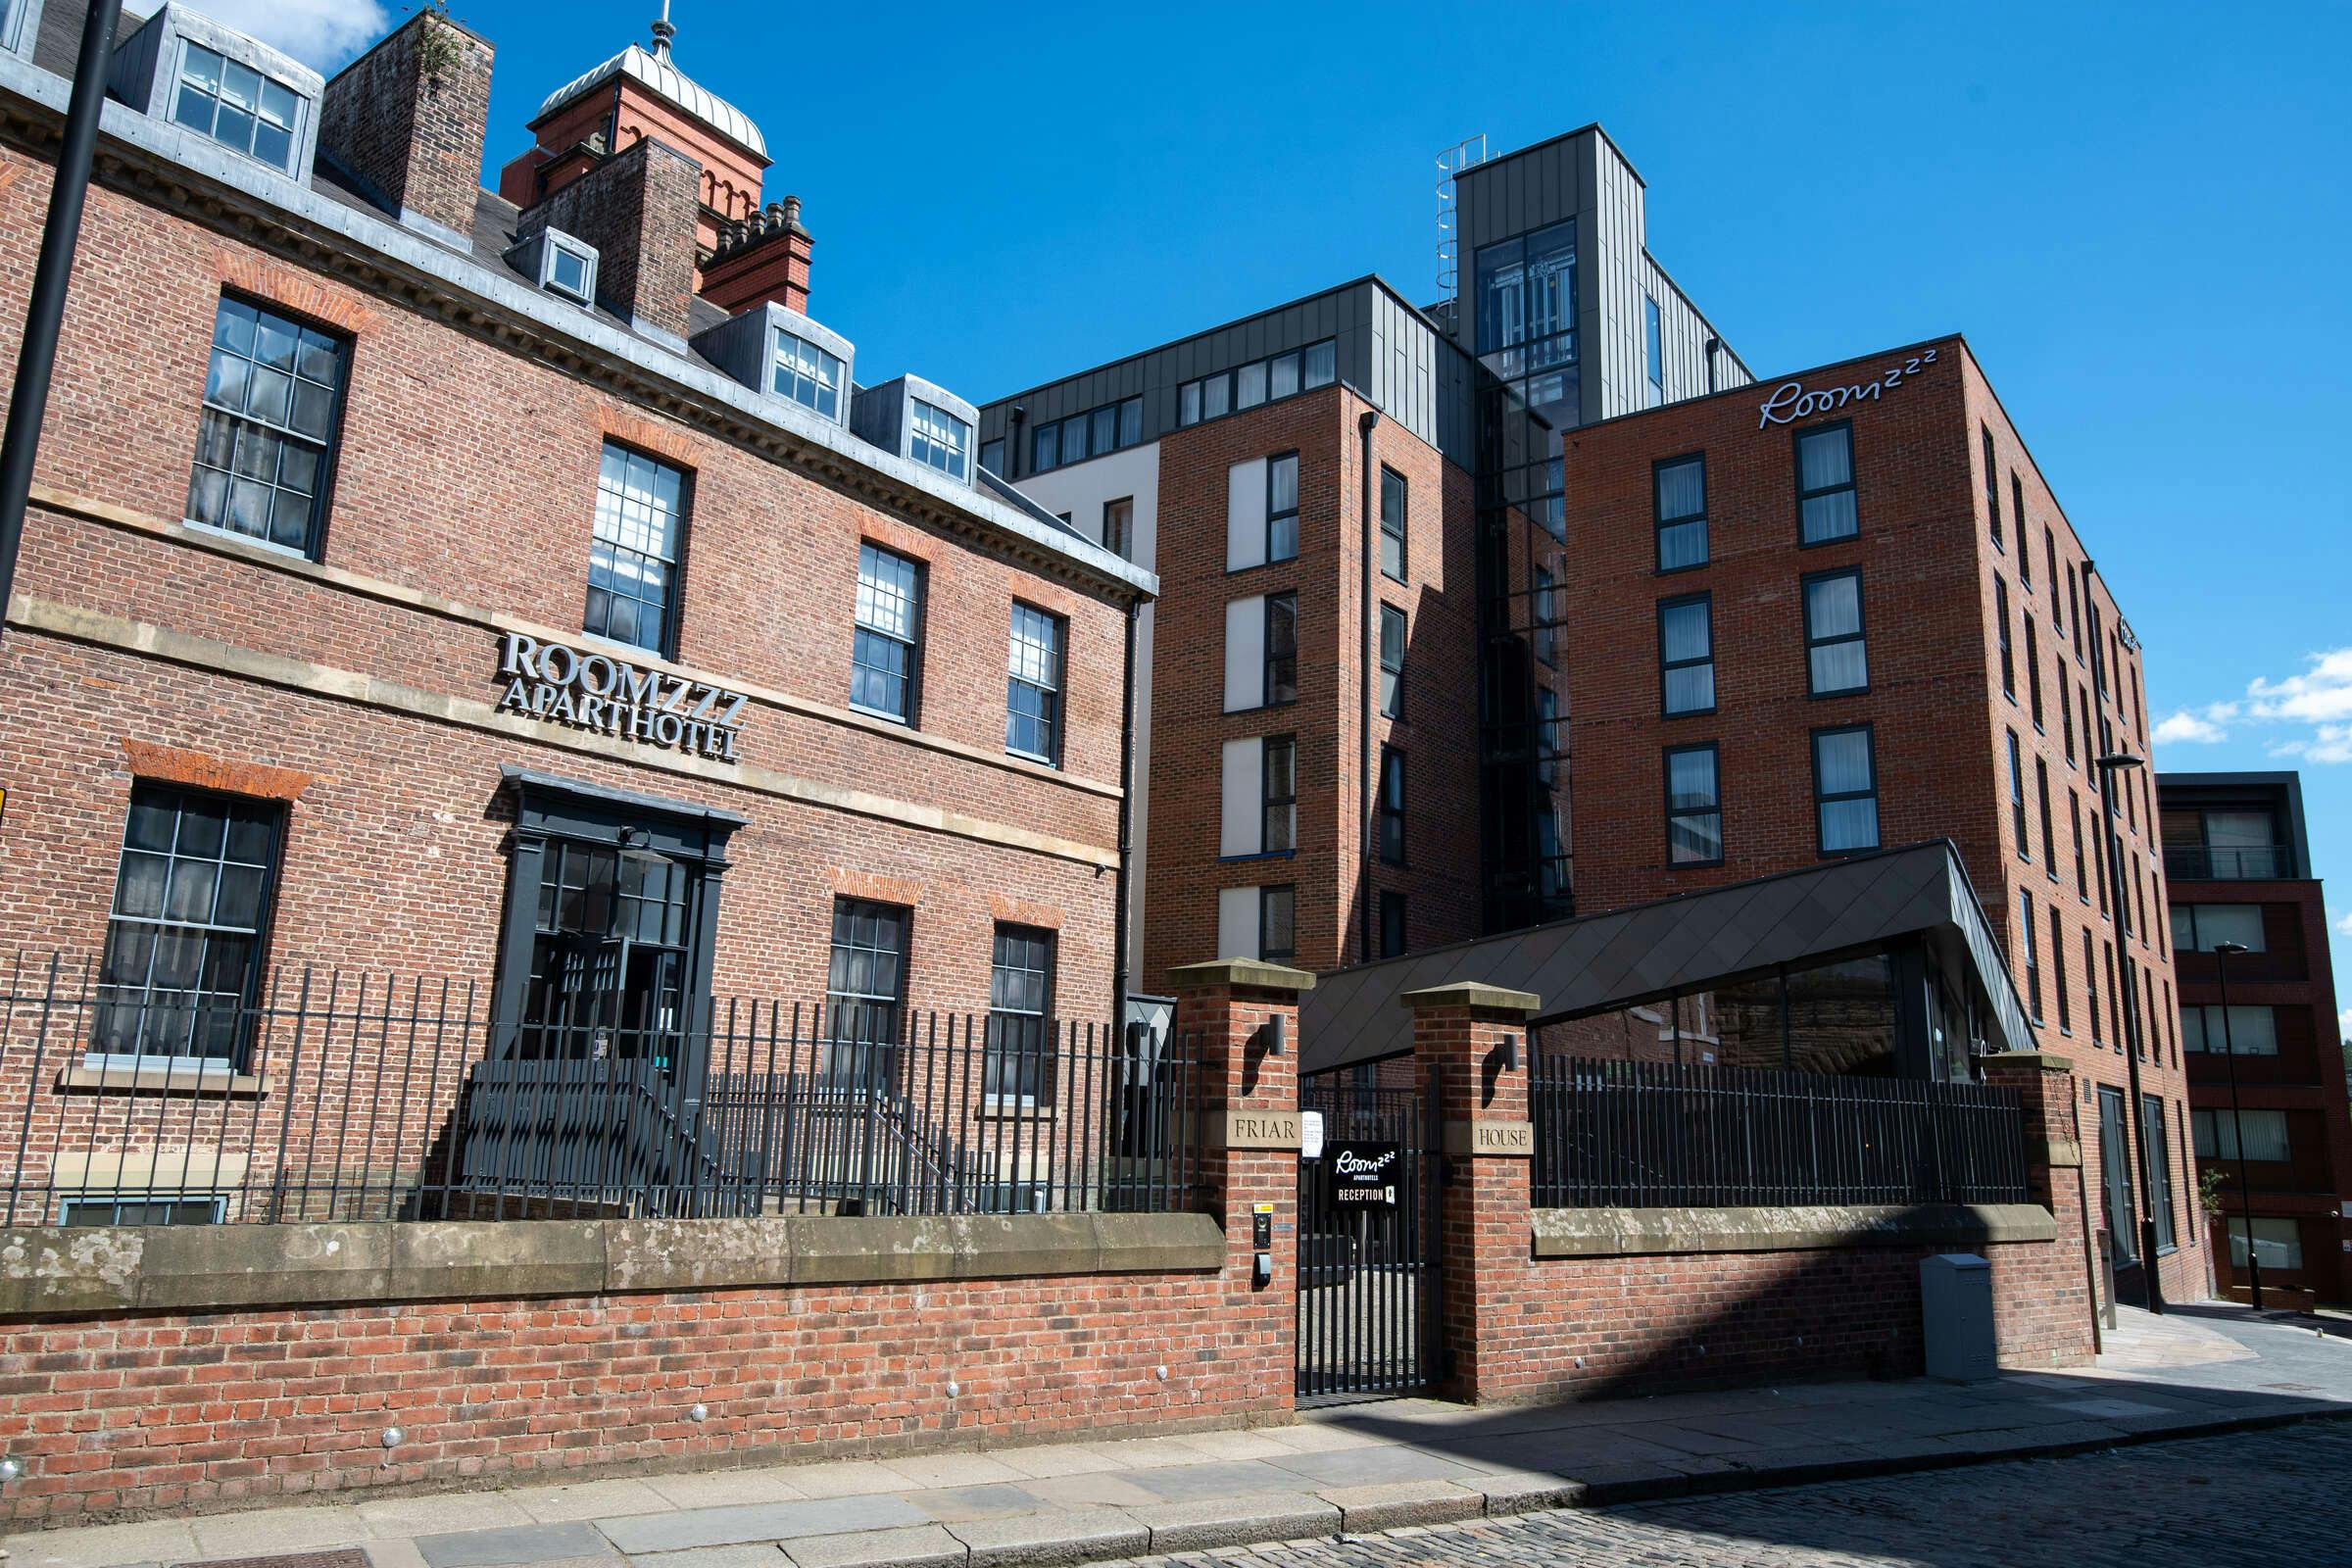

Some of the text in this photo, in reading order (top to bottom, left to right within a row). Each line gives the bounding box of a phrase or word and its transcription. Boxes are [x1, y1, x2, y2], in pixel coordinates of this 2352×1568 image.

[502, 631, 749, 730] ROOMZZZ
[501, 677, 742, 760] APARTHOTEL
[1235, 1119, 1295, 1138] FRIAR
[1480, 1128, 1527, 1146] HOUSE
[1338, 1189, 1384, 1200] RECEPTION
